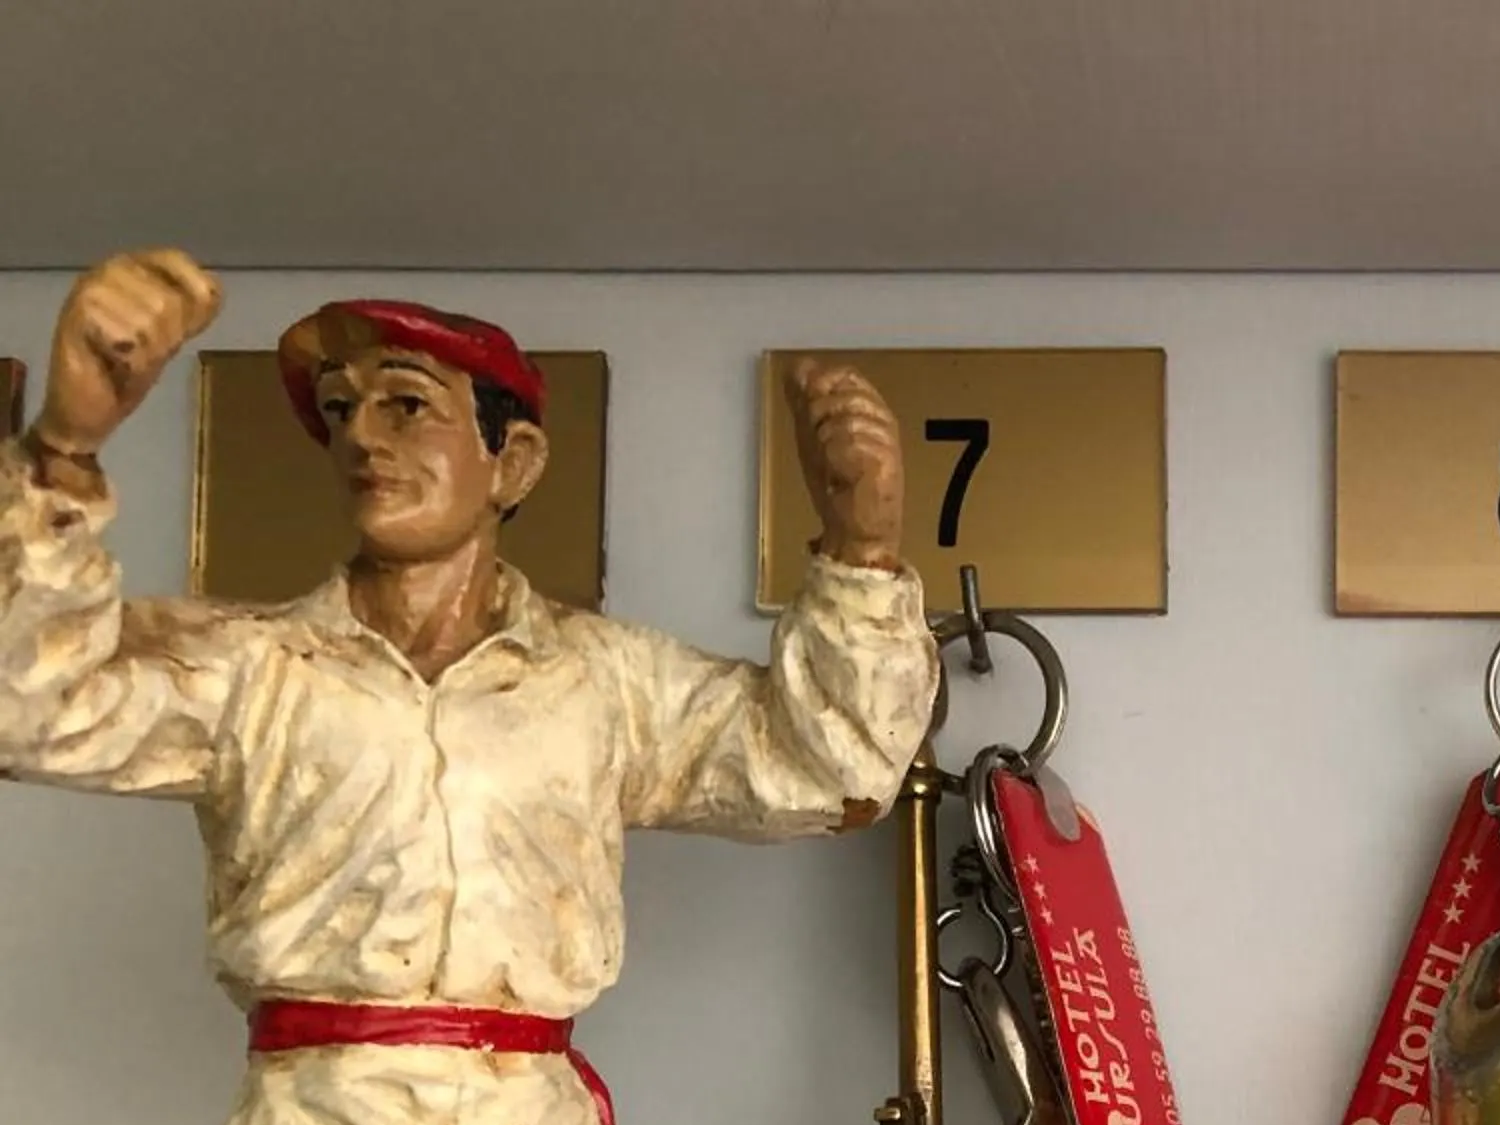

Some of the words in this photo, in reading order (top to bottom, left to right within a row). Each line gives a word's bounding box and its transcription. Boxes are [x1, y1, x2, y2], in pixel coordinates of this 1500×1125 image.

[924, 418, 990, 547] 7
[1050, 940, 1111, 1104] HOTEL
[1377, 941, 1471, 1096] HOTEL
